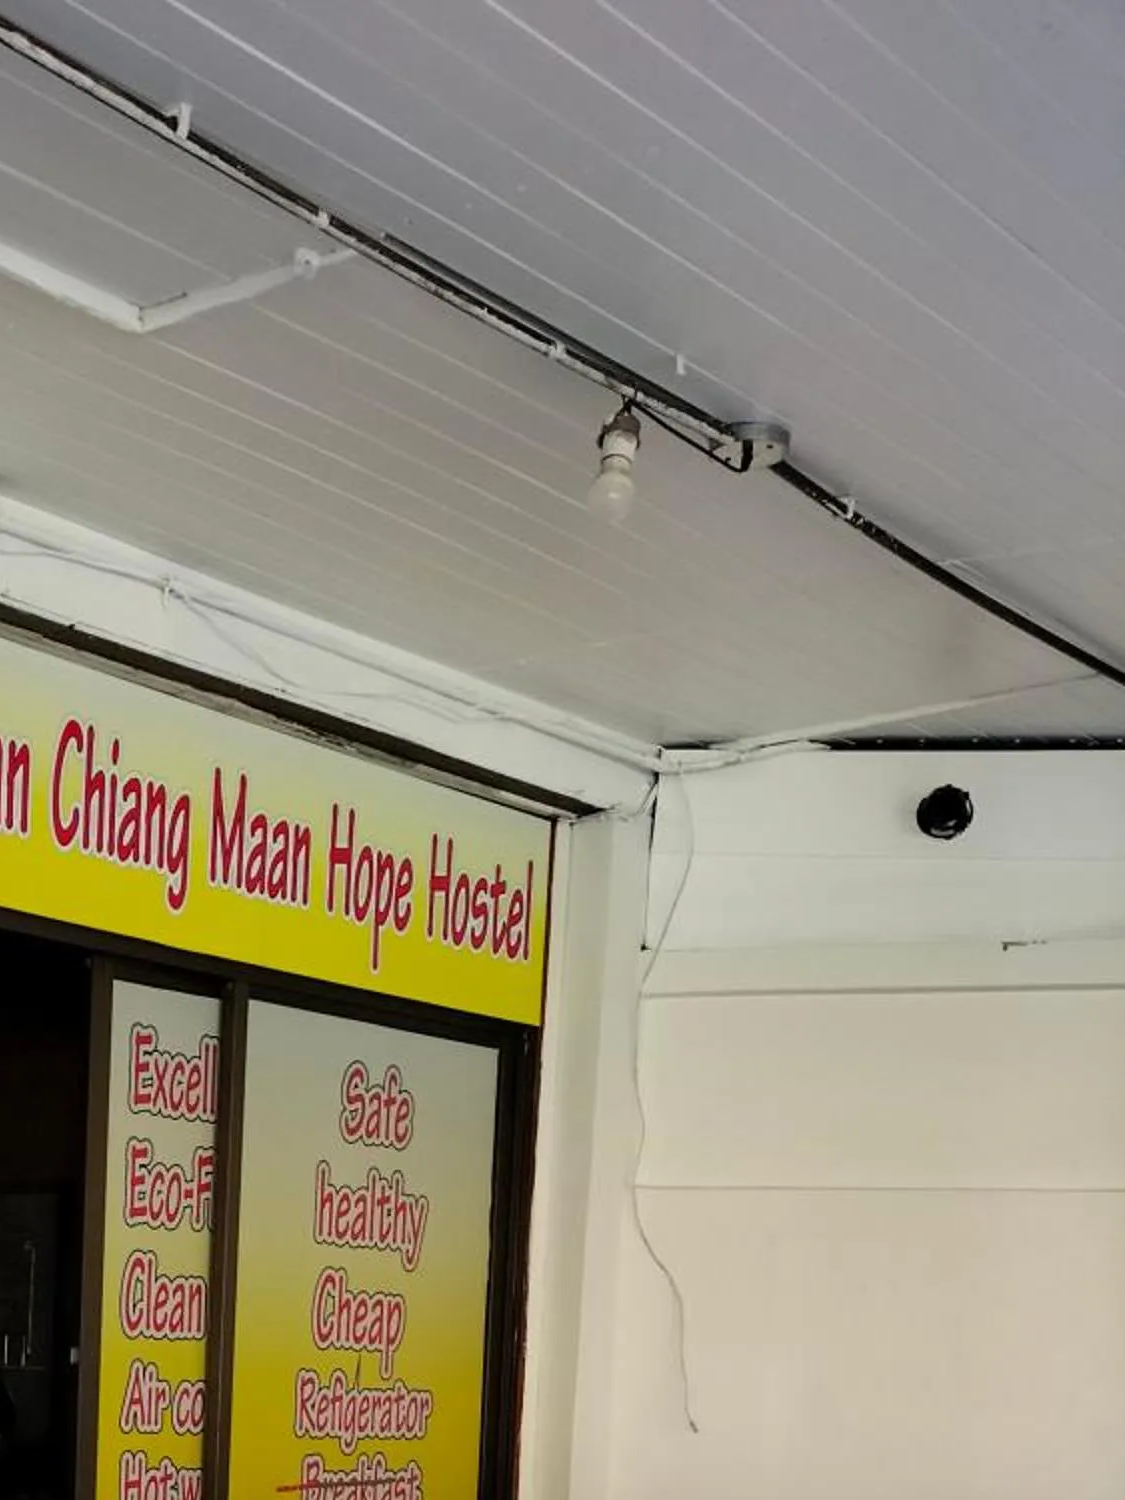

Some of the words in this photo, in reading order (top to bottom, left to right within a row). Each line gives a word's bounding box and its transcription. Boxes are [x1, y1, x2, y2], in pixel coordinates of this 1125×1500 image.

[51, 717, 191, 911] Chiang
[207, 765, 313, 908] Maan
[324, 801, 415, 974] Hope
[426, 831, 536, 963] Hostel
[341, 1061, 414, 1150] Safe
[314, 1161, 428, 1271] healthy
[122, 1251, 207, 1339] Clean
[312, 1266, 405, 1378] Cheap
[120, 1360, 169, 1433] Air
